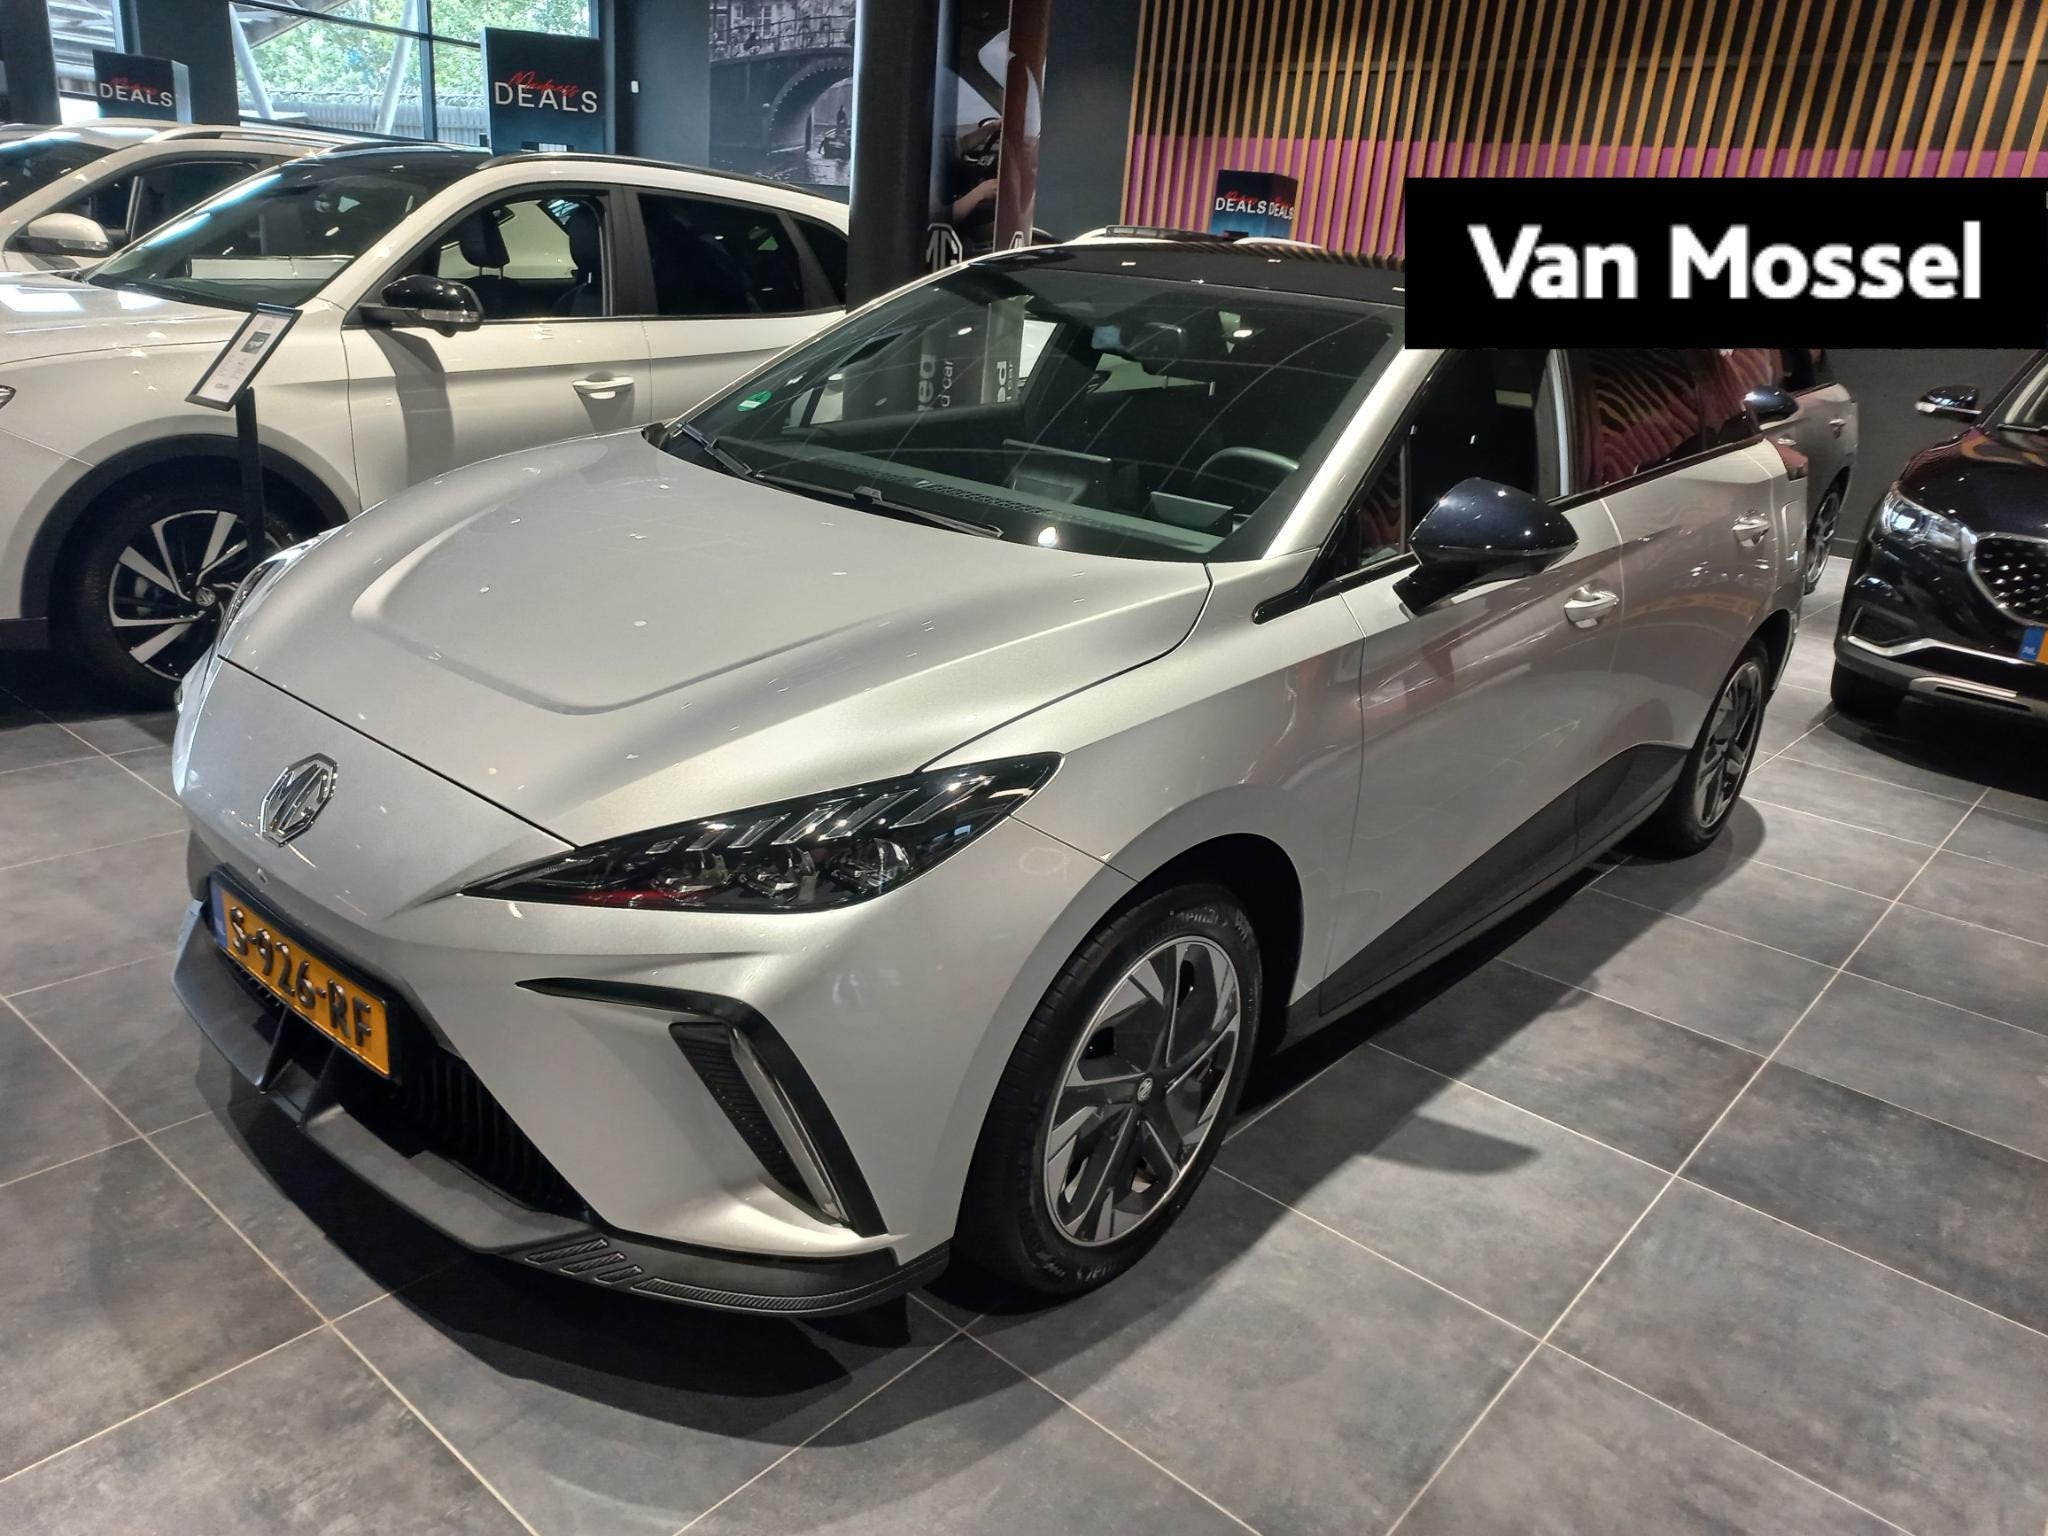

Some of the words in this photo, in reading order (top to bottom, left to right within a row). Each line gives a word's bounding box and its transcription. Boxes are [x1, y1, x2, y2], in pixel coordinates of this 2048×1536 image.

[99, 83, 173, 107] DEALS
[494, 81, 598, 114] DEALS
[1215, 197, 1267, 214] DEALS
[1268, 202, 1294, 220] DEALS
[230, 905, 373, 1047] S-926-RF
